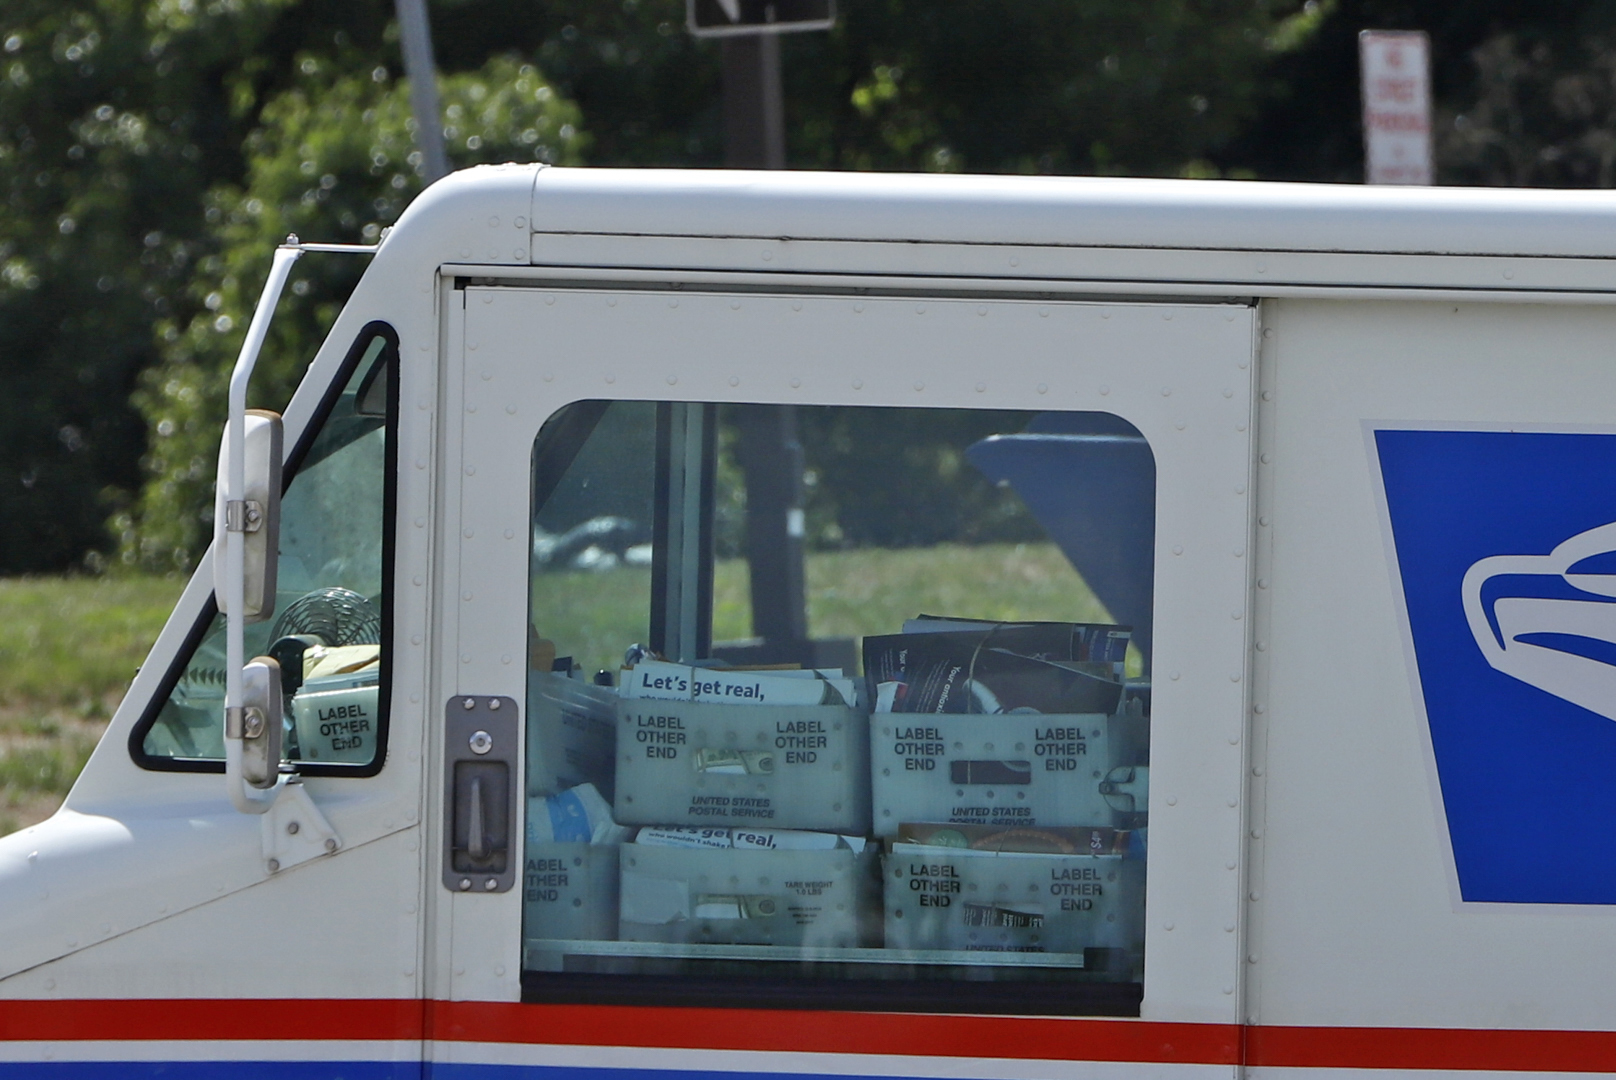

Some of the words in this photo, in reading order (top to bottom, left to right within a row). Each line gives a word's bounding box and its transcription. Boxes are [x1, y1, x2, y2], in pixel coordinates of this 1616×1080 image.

[948, 666, 962, 683] Your
[642, 672, 687, 691] Let's
[694, 679, 721, 696] get
[725, 683, 765, 701] real,
[318, 704, 367, 721] LABEL
[637, 715, 685, 729] LABEL
[776, 721, 826, 733] LABEL
[320, 721, 370, 737] OTHER
[895, 728, 943, 740] LABEL
[1035, 728, 1085, 740] LABEL
[636, 730, 686, 745] OTHER
[775, 736, 827, 749] OTHER
[646, 746, 677, 759] END
[894, 743, 945, 756] OTHER
[1034, 743, 1087, 756] OTHER
[786, 751, 817, 764] END
[905, 758, 935, 771] END
[1045, 758, 1077, 771] END
[692, 796, 730, 806] UNITED
[731, 797, 770, 808] STATES
[688, 806, 728, 816] POSTAL
[731, 807, 775, 819] SERVICE
[952, 807, 990, 816] UNITED
[991, 807, 1031, 816] STATES
[737, 831, 777, 849] real,
[527, 859, 568, 872] ABEL
[910, 864, 960, 878] LABEL
[527, 874, 569, 887] THER
[1051, 868, 1101, 881] LABEL
[909, 879, 961, 893] OTHER
[1050, 883, 1103, 896] OTHER
[919, 894, 951, 907] END
[1061, 898, 1093, 911] END
